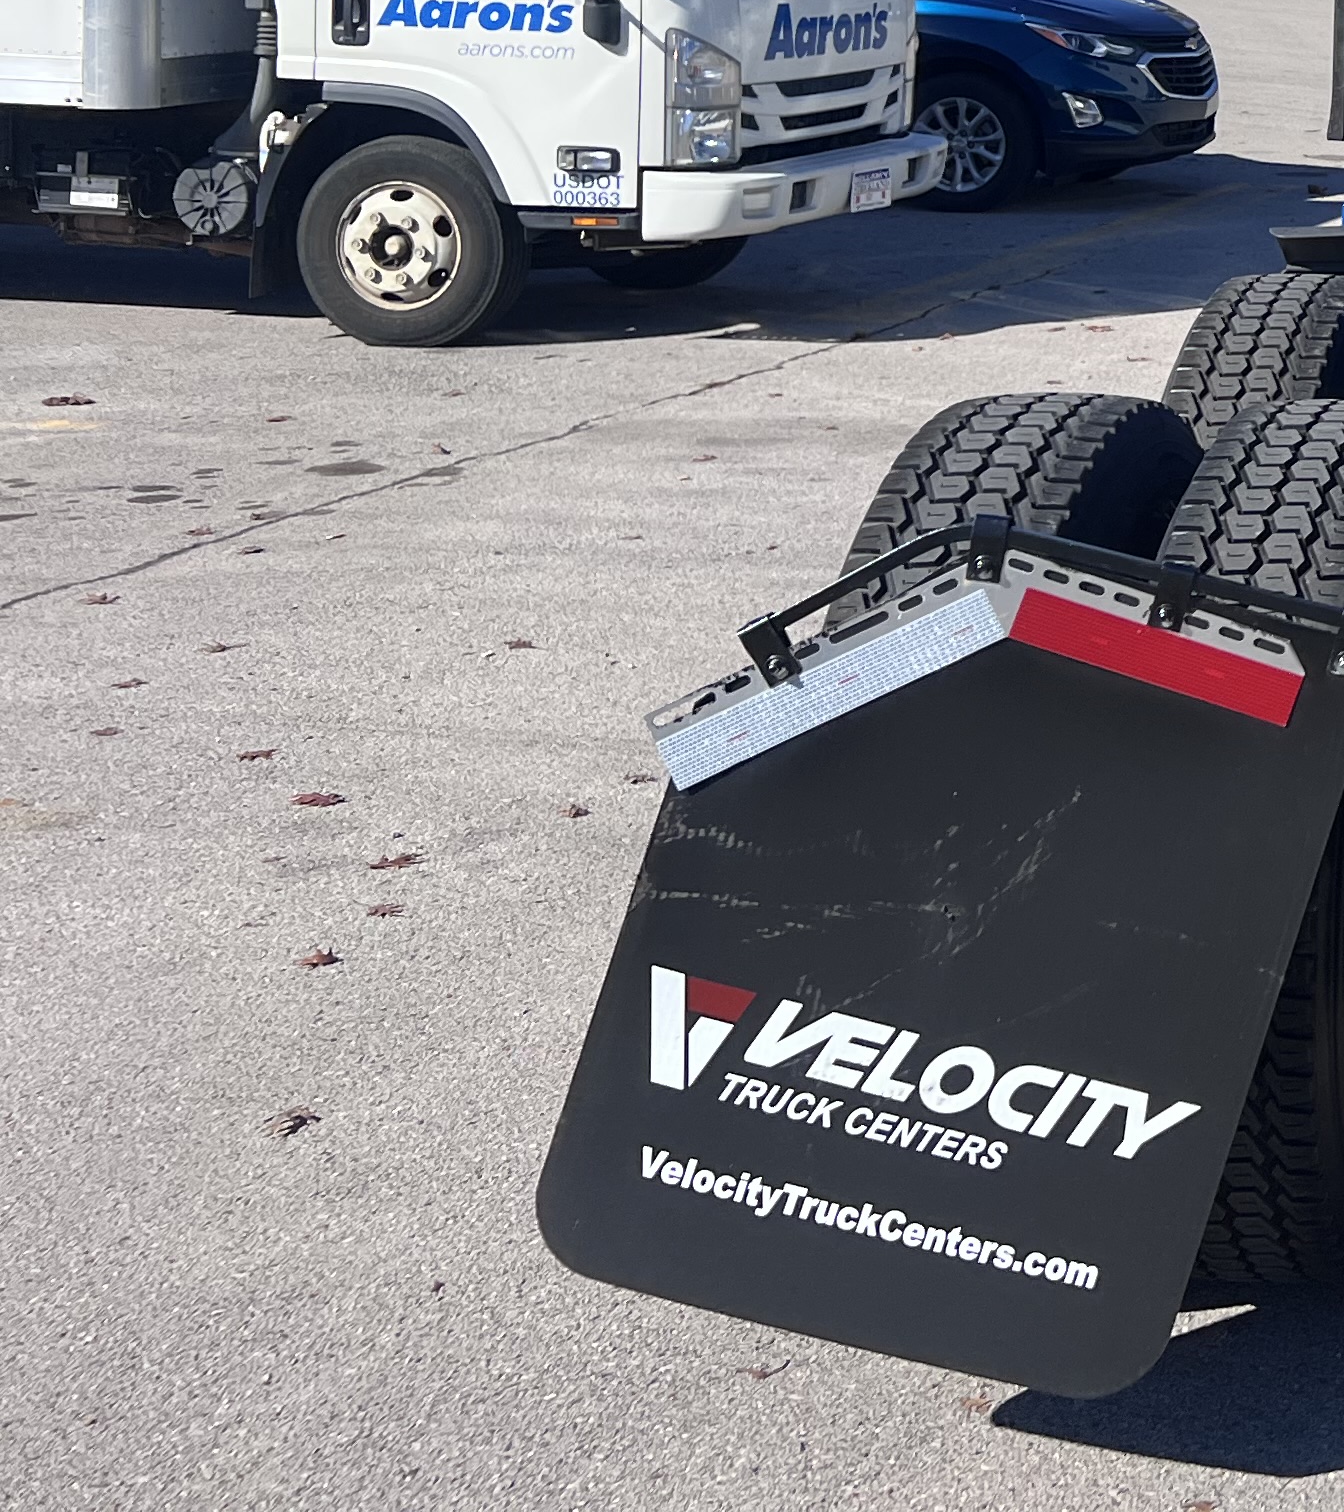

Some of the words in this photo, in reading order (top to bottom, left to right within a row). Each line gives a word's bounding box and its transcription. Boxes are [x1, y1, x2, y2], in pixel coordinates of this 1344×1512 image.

[457, 42, 575, 61] aarons.com
[764, 2, 888, 61] Aaron's
[554, 173, 624, 190] USDOT
[554, 190, 621, 207] 000363
[743, 999, 1201, 1159] VELOCITY
[717, 1073, 845, 1128] TRUCK
[844, 1106, 1009, 1171] CENTERS
[641, 1145, 1100, 1290] VelocityTruckCenters.com
